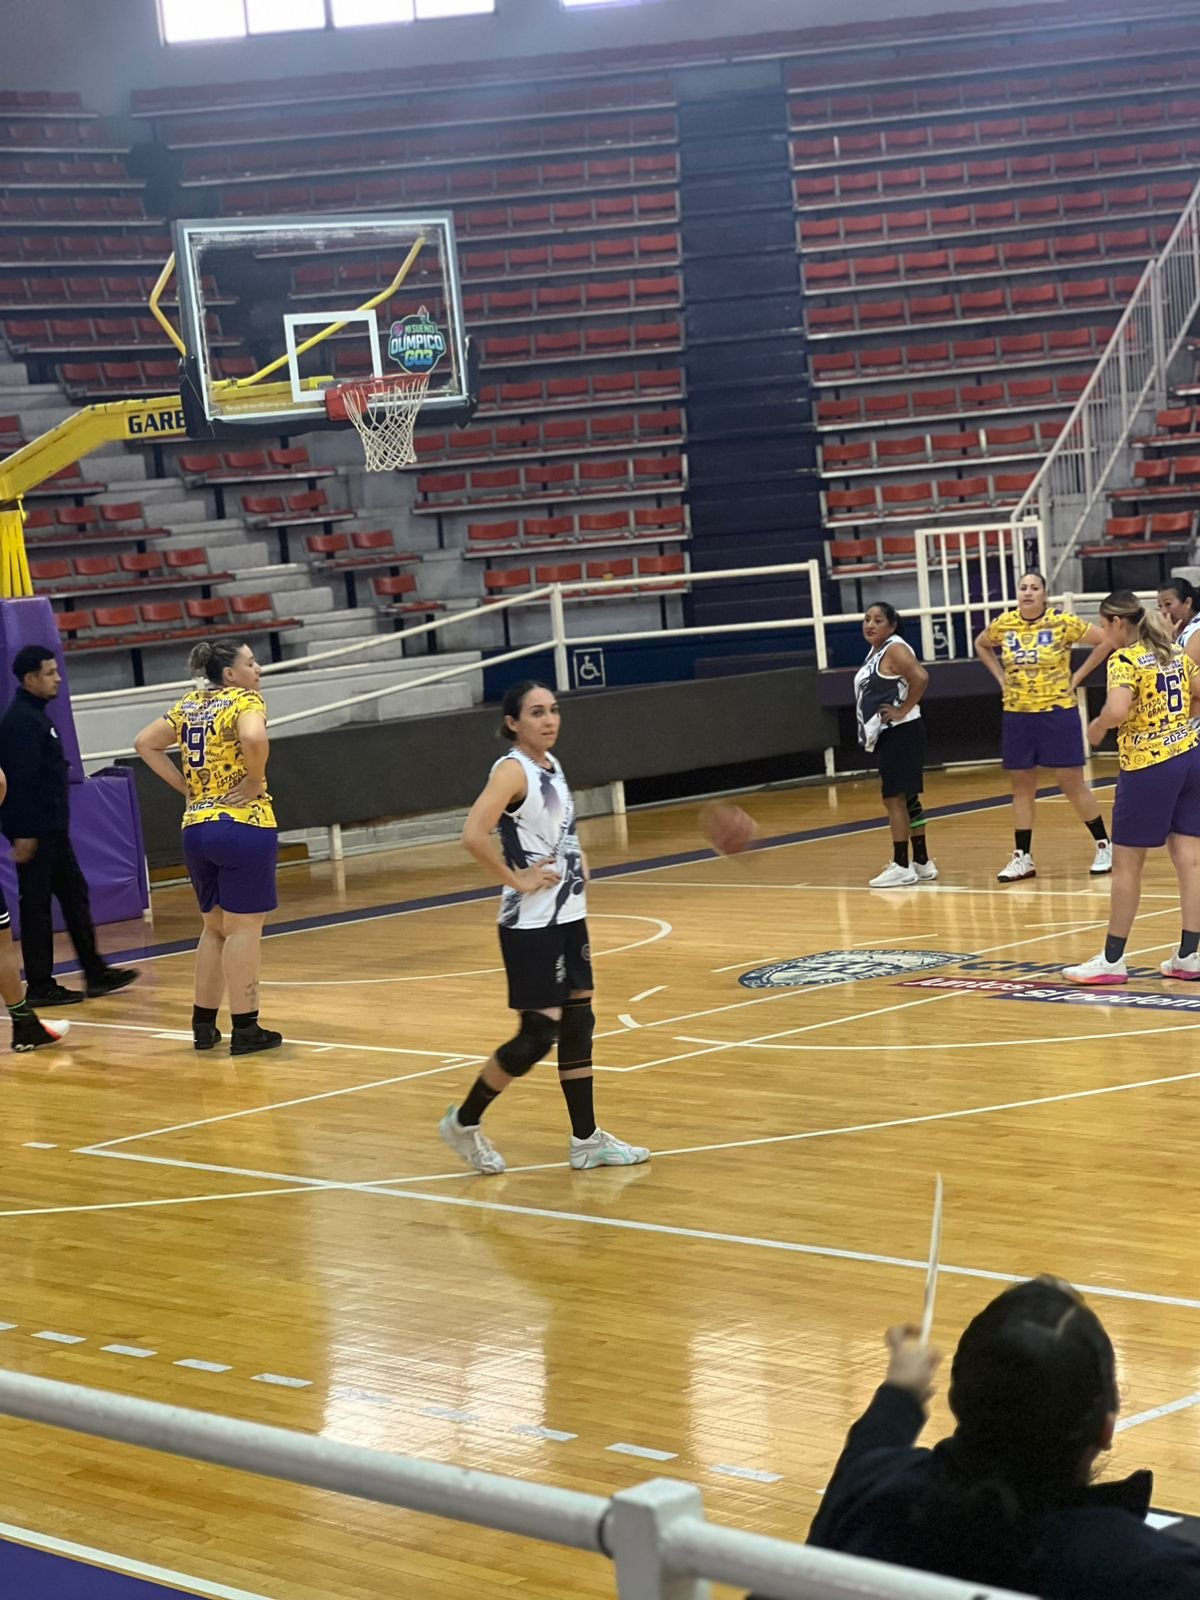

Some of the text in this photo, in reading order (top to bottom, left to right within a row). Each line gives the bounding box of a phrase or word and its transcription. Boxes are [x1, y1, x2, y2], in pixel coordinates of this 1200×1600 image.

[390, 333, 443, 355] OLÍMPICO
[1015, 650, 1037, 665] 23
[1165, 674, 1183, 713] 6
[1163, 729, 1189, 746] 2025
[187, 727, 206, 768] 9
[903, 977, 1034, 990] Juntos
